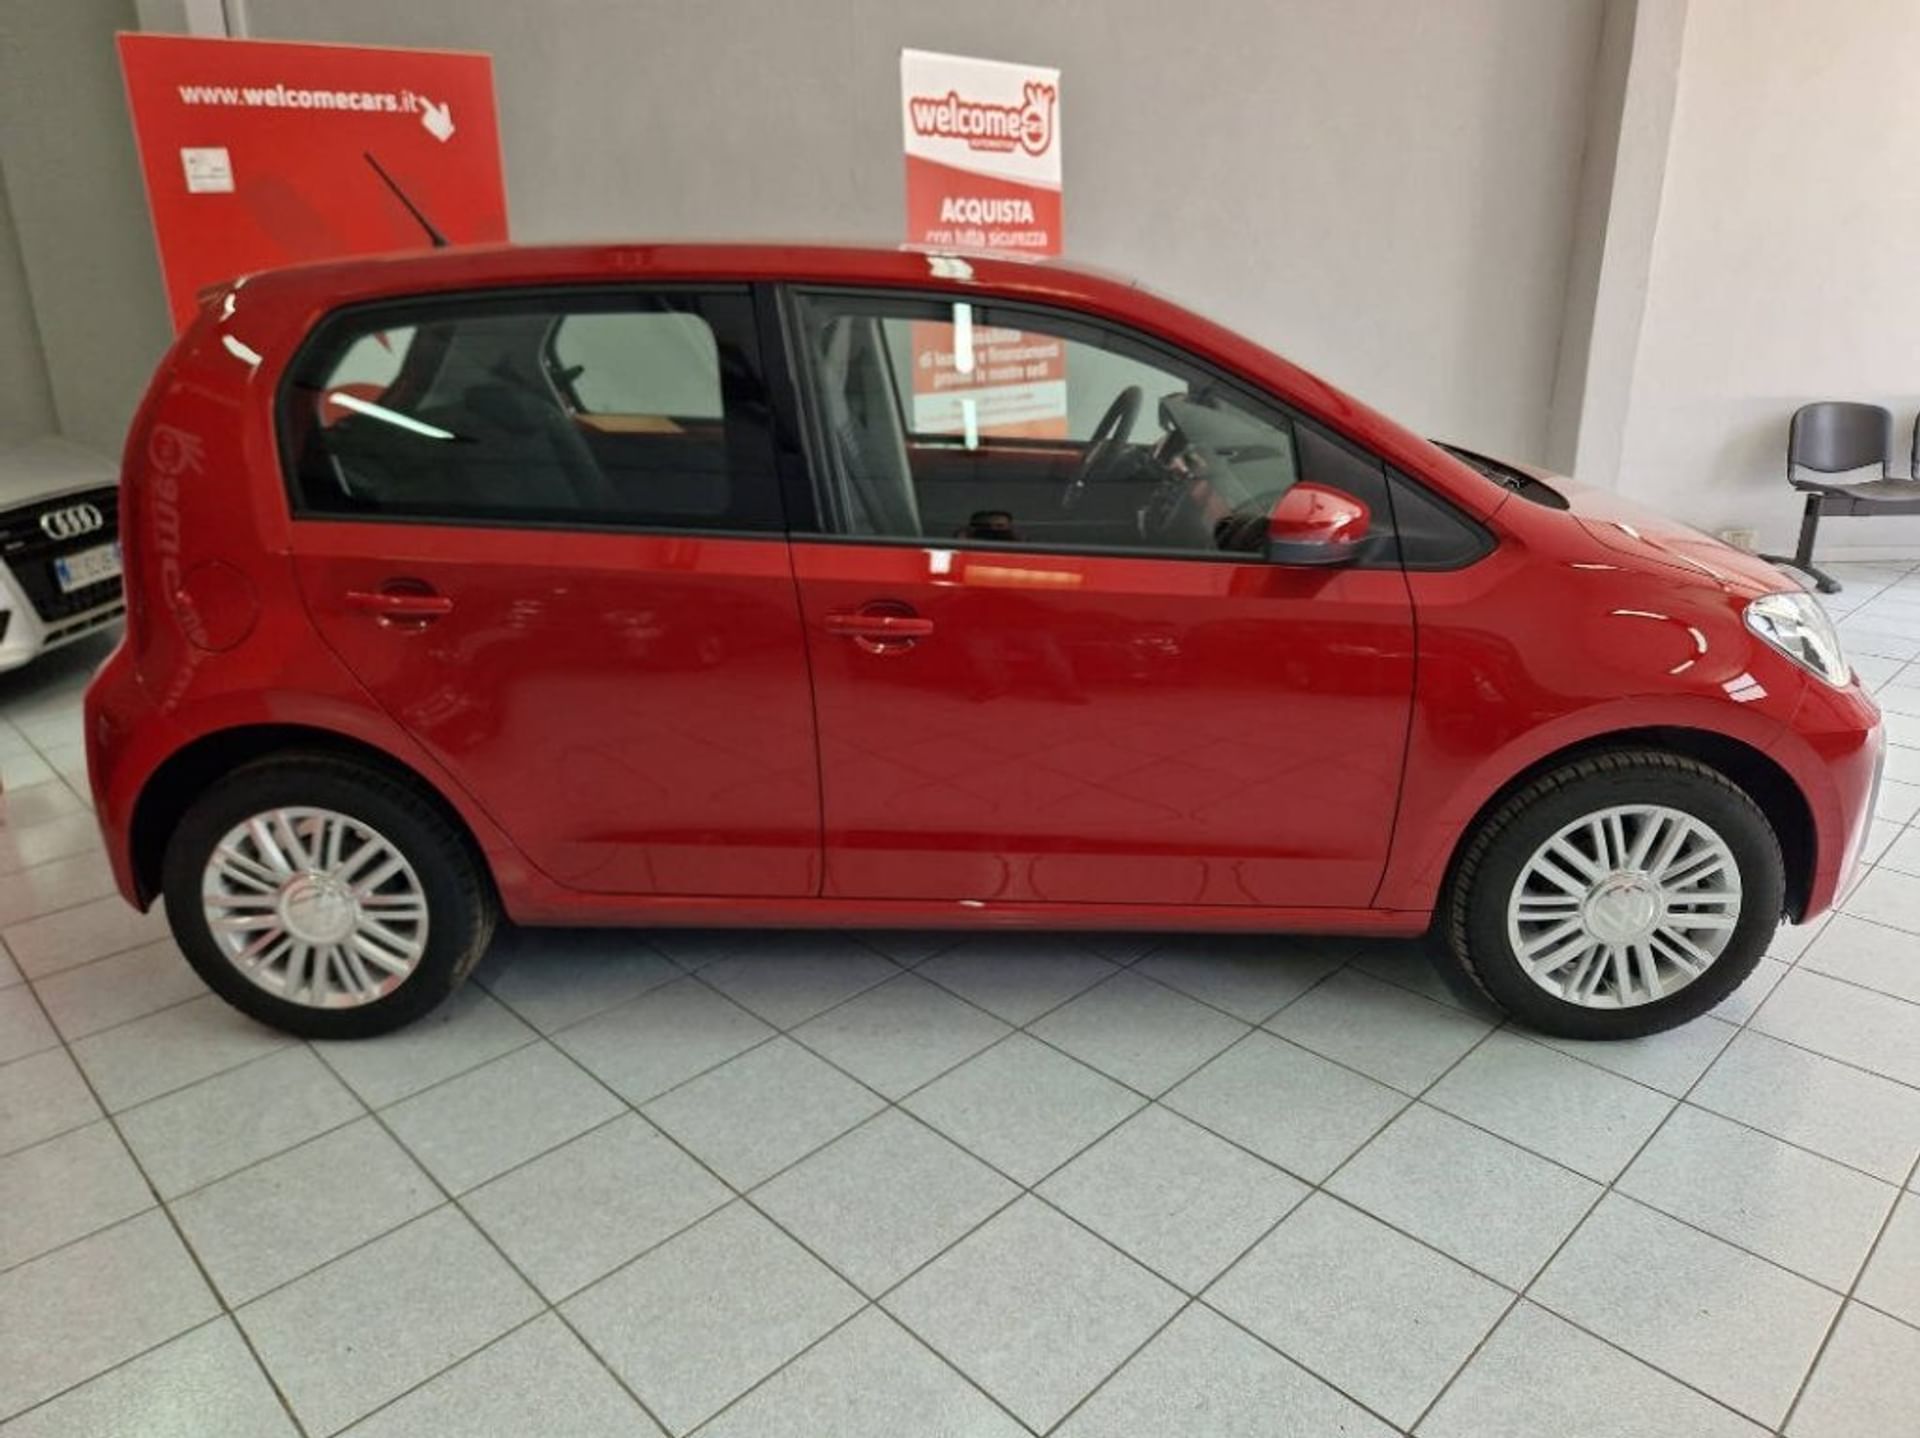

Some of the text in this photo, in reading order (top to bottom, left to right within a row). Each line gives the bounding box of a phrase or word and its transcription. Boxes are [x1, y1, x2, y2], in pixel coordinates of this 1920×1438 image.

[179, 84, 419, 113] www.welcomecars.it
[910, 91, 1022, 141] welcome
[940, 197, 1034, 225] ACQUISTA
